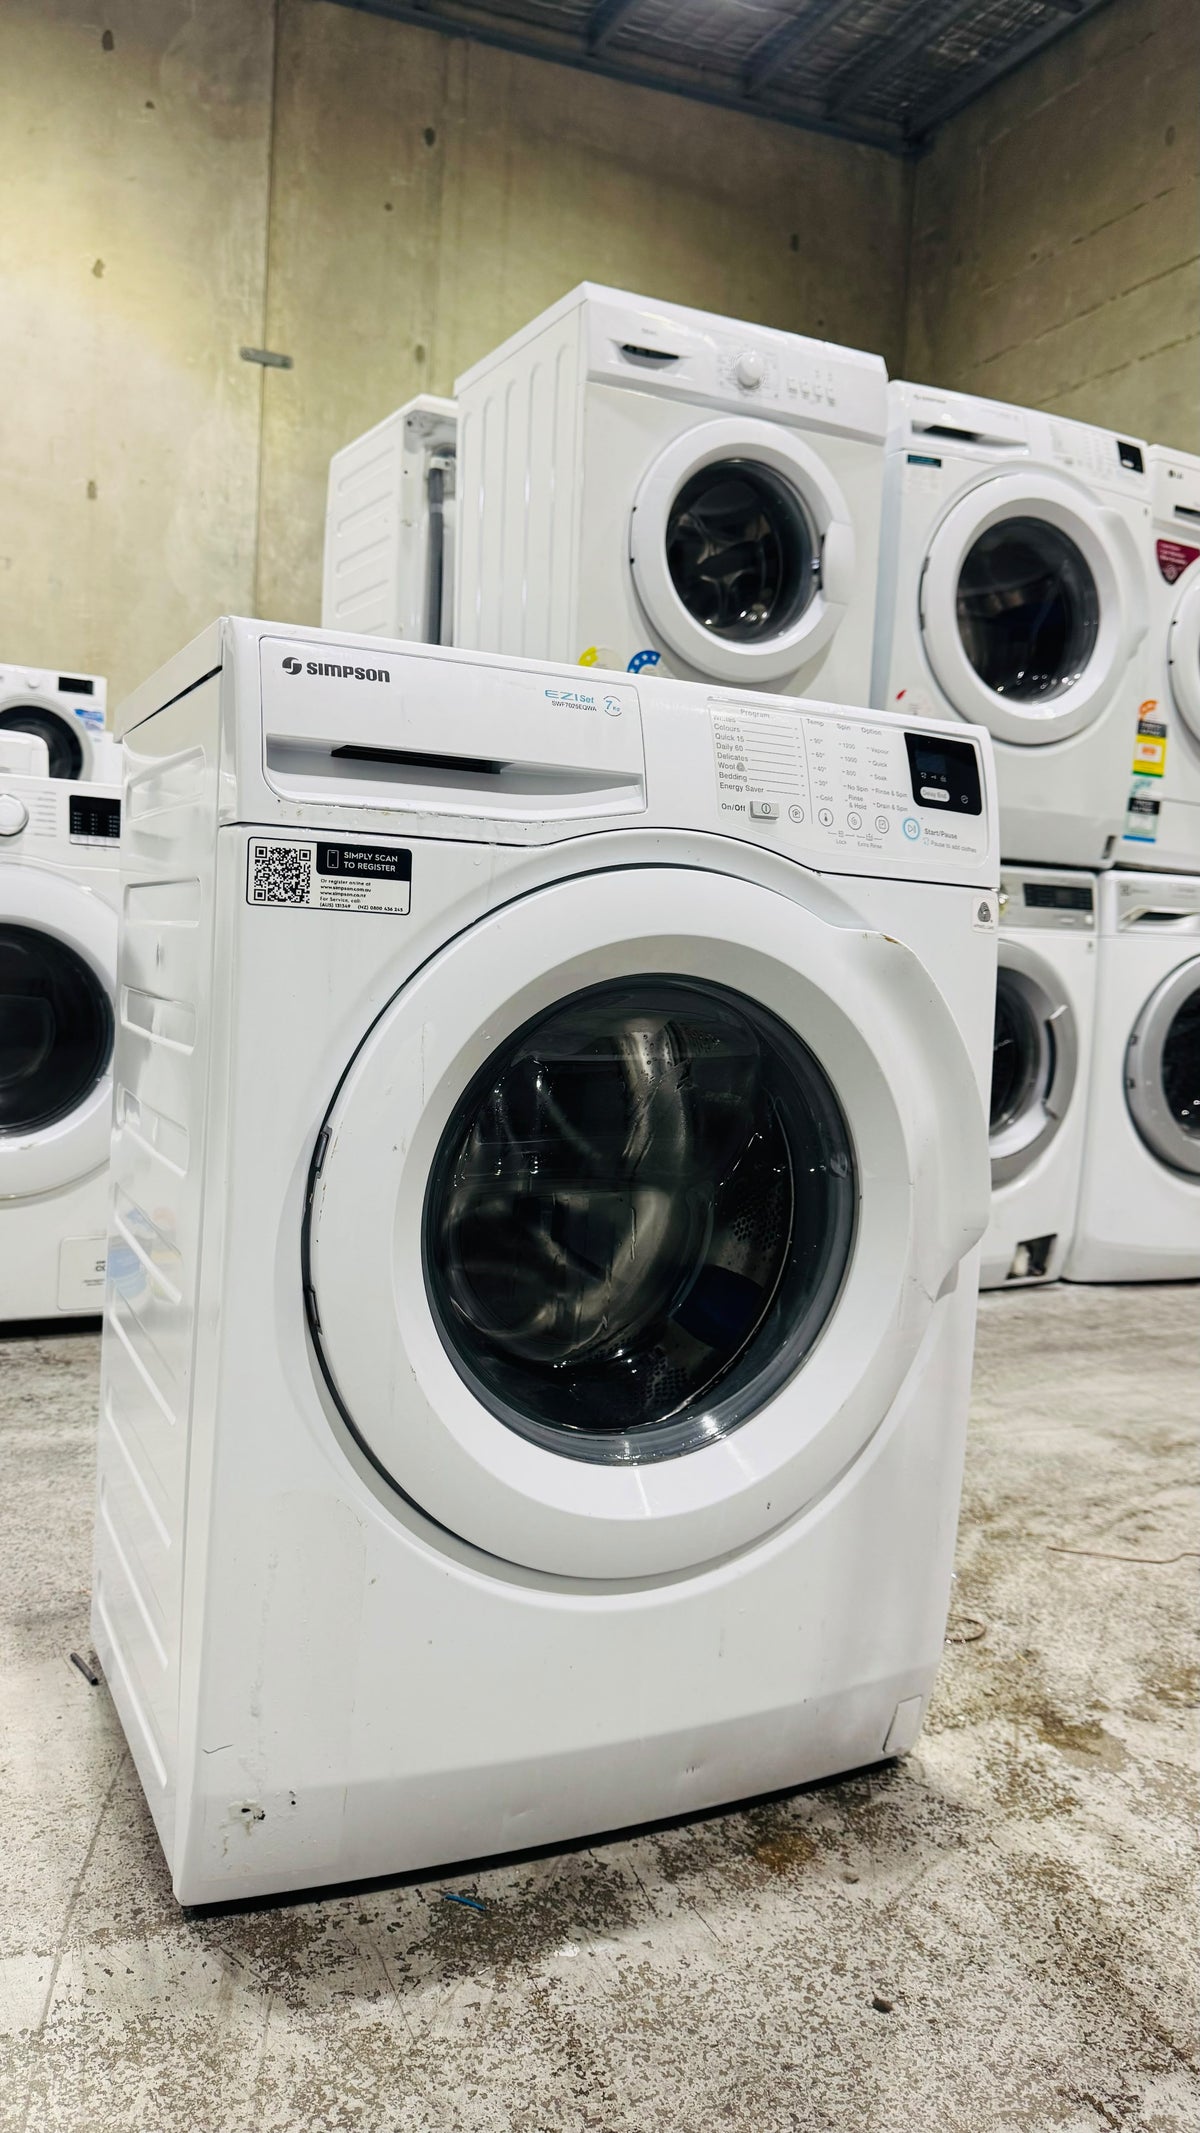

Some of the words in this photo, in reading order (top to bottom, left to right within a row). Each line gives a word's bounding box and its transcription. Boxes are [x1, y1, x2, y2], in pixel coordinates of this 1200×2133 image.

[306, 662, 390, 682] SIMPSON
[580, 694, 594, 704] Set
[605, 700, 613, 710] 7
[740, 708, 770, 718] Program
[714, 723, 741, 732] Colours
[807, 718, 824, 727] Temp
[715, 733, 735, 741] Quick
[716, 743, 733, 751] Daily
[717, 752, 748, 762] Delicates
[719, 772, 747, 782] Bedding
[720, 782, 743, 792] Energy
[721, 802, 746, 812] On/Off
[924, 828, 958, 840] Start/Pause
[344, 852, 372, 860] SIMPLY
[358, 863, 396, 872] REGISTER
